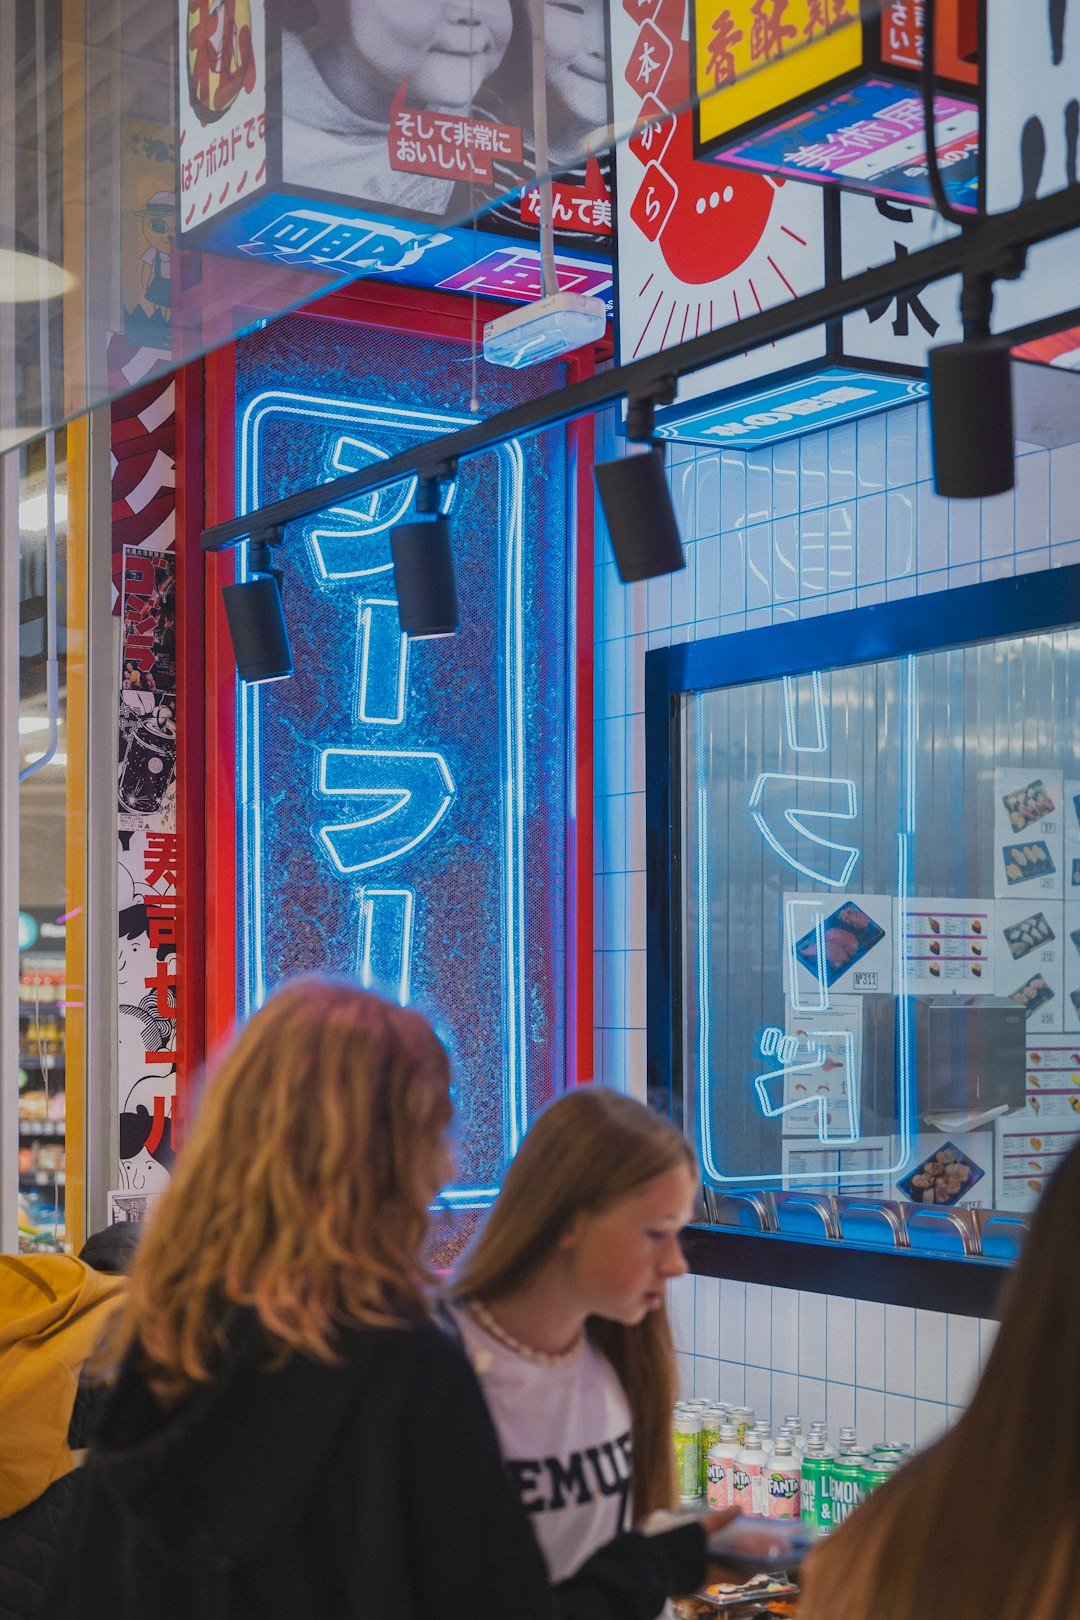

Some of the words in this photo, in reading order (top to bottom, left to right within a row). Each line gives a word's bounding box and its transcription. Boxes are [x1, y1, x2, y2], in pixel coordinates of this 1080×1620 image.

[395, 112, 512, 154] そして非常に
[769, 1478, 800, 1497] FANTA
[820, 1503, 831, 1519] &
